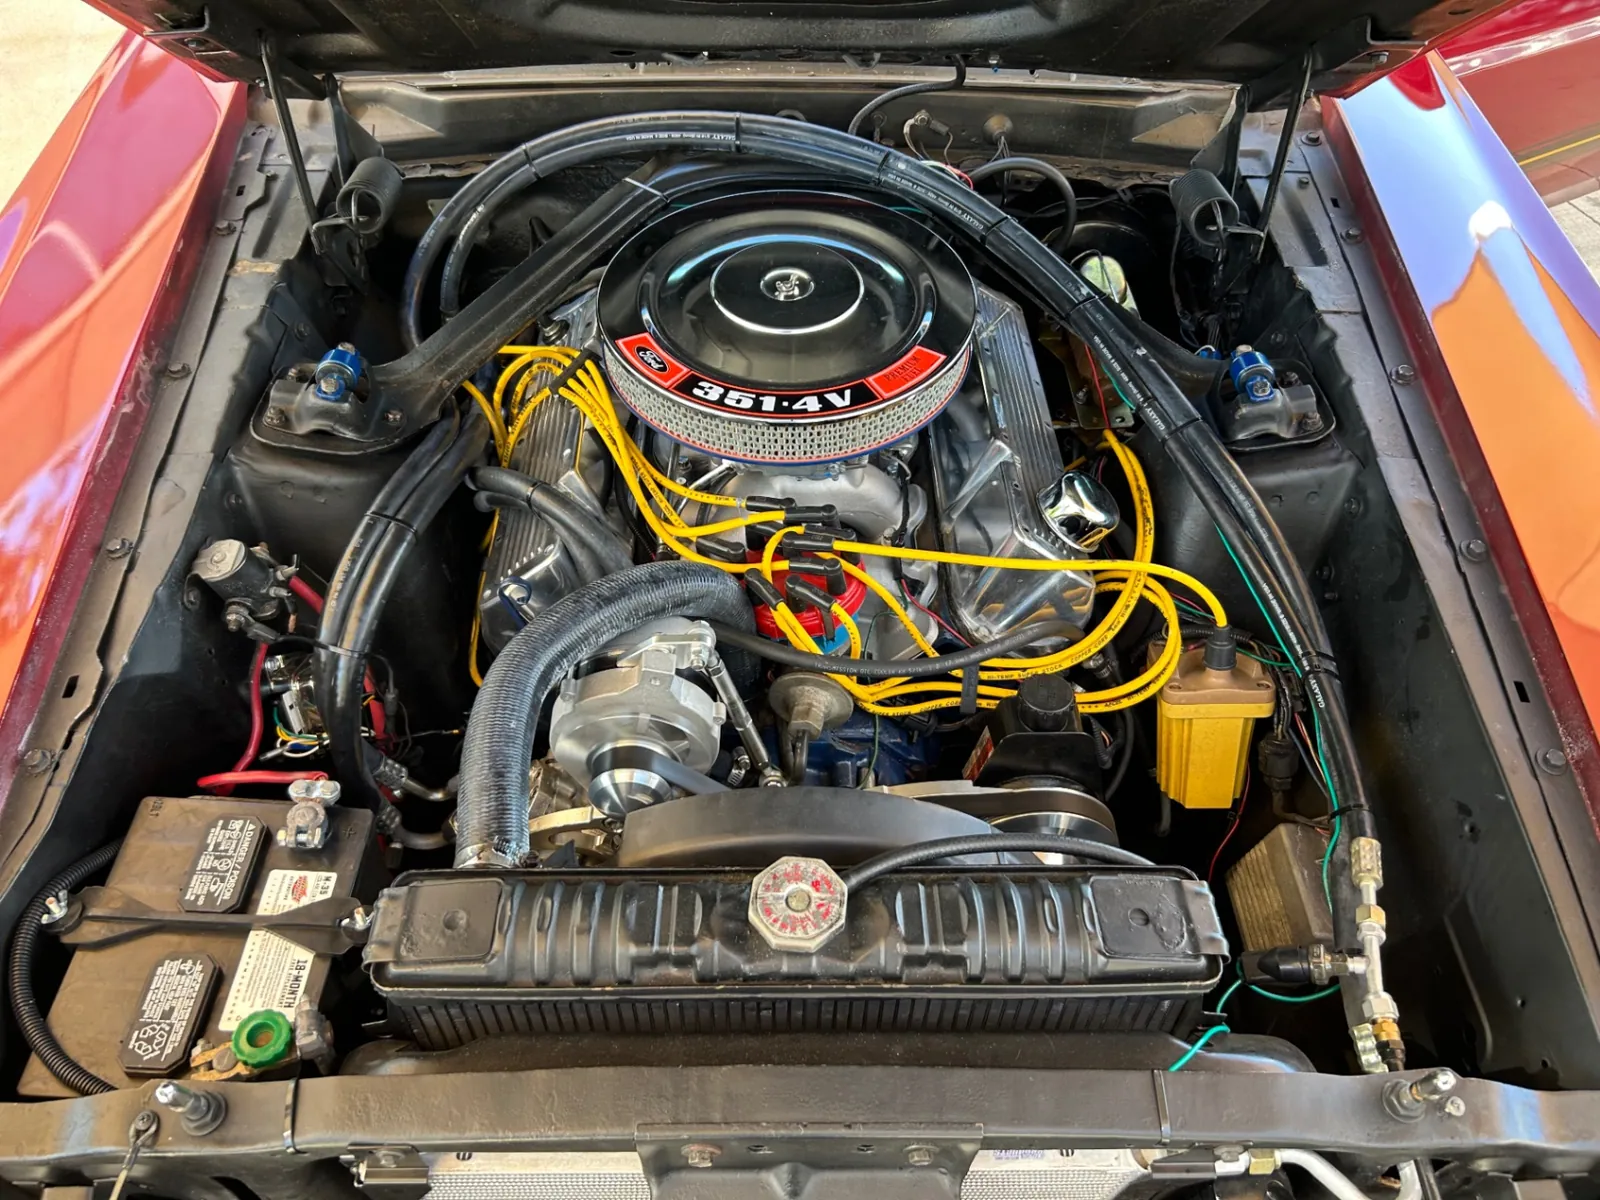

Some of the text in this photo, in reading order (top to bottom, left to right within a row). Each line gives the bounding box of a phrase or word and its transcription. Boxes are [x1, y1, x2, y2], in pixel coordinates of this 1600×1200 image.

[899, 177, 913, 188] MADE
[960, 212, 984, 229] GALAXY
[1092, 334, 1102, 345] USA
[639, 348, 664, 371] Ford
[1100, 346, 1113, 360] MADE
[1111, 361, 1121, 372] SIZE
[509, 416, 521, 435] STOCK
[1147, 406, 1165, 430] GALAXY
[501, 440, 512, 463] COPPER
[1260, 581, 1272, 594] USA
[1270, 597, 1282, 614] MADE
[813, 660, 857, 674] TRANSMISSION
[987, 672, 1014, 680] HI-TEMP
[1016, 668, 1039, 679] SUPER
[1041, 662, 1064, 674] STOCK
[1069, 647, 1093, 663] COPPER
[918, 703, 942, 712] COPPER
[1103, 698, 1123, 707] ACCEL
[1126, 685, 1150, 701] HI-TEMP
[1151, 666, 1168, 685] SUPER
[1309, 678, 1325, 708] GALAXY
[240, 829, 254, 863] DANGER
[223, 869, 241, 901] POISON
[280, 971, 294, 1010] REPLACEMENT
[284, 959, 308, 1009] 18-MONTH
